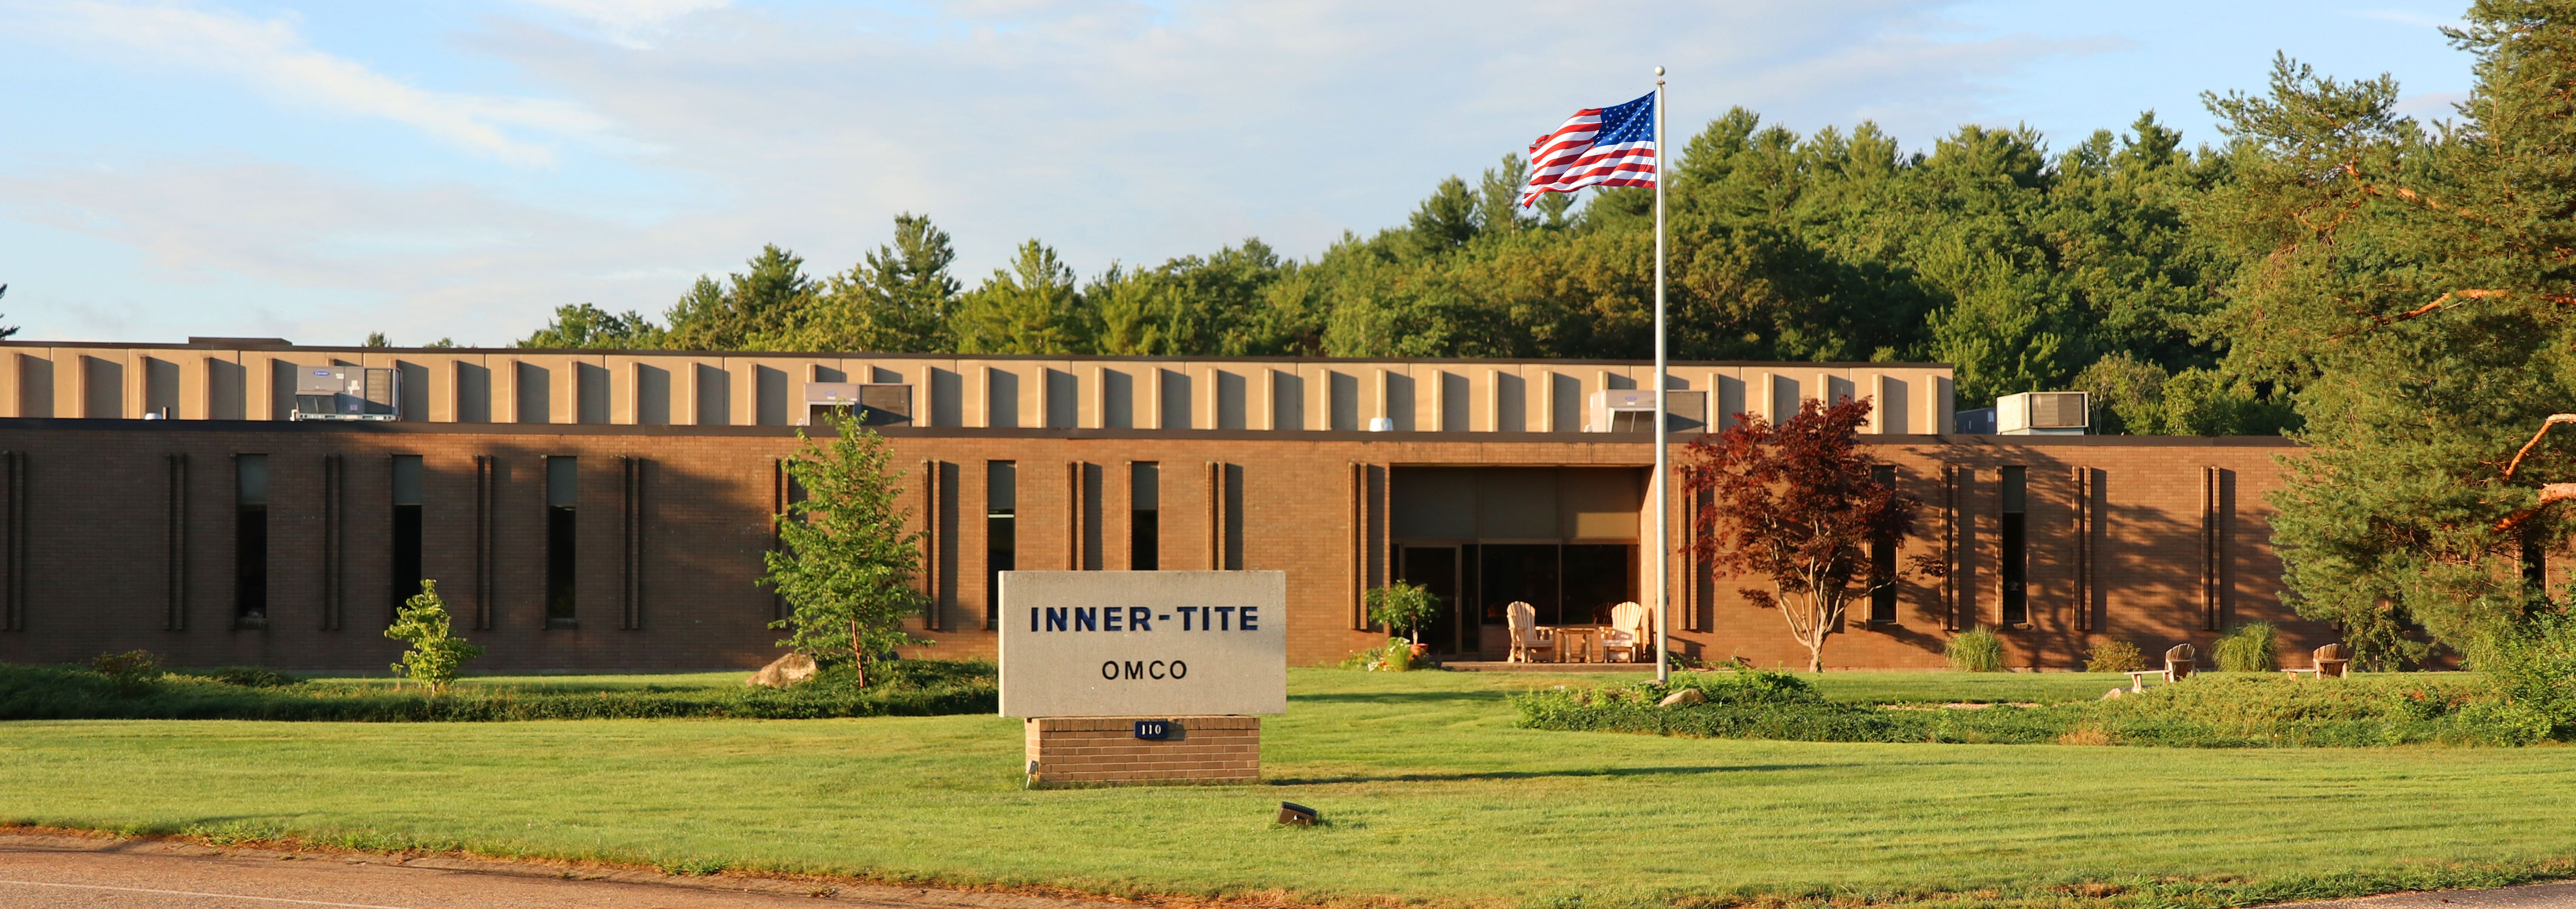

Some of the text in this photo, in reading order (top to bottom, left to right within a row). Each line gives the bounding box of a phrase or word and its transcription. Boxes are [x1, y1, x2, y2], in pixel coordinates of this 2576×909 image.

[1031, 606, 1258, 632] INNER-TITE
[1102, 660, 1187, 680] OMCO
[1142, 724, 1161, 735] 110
